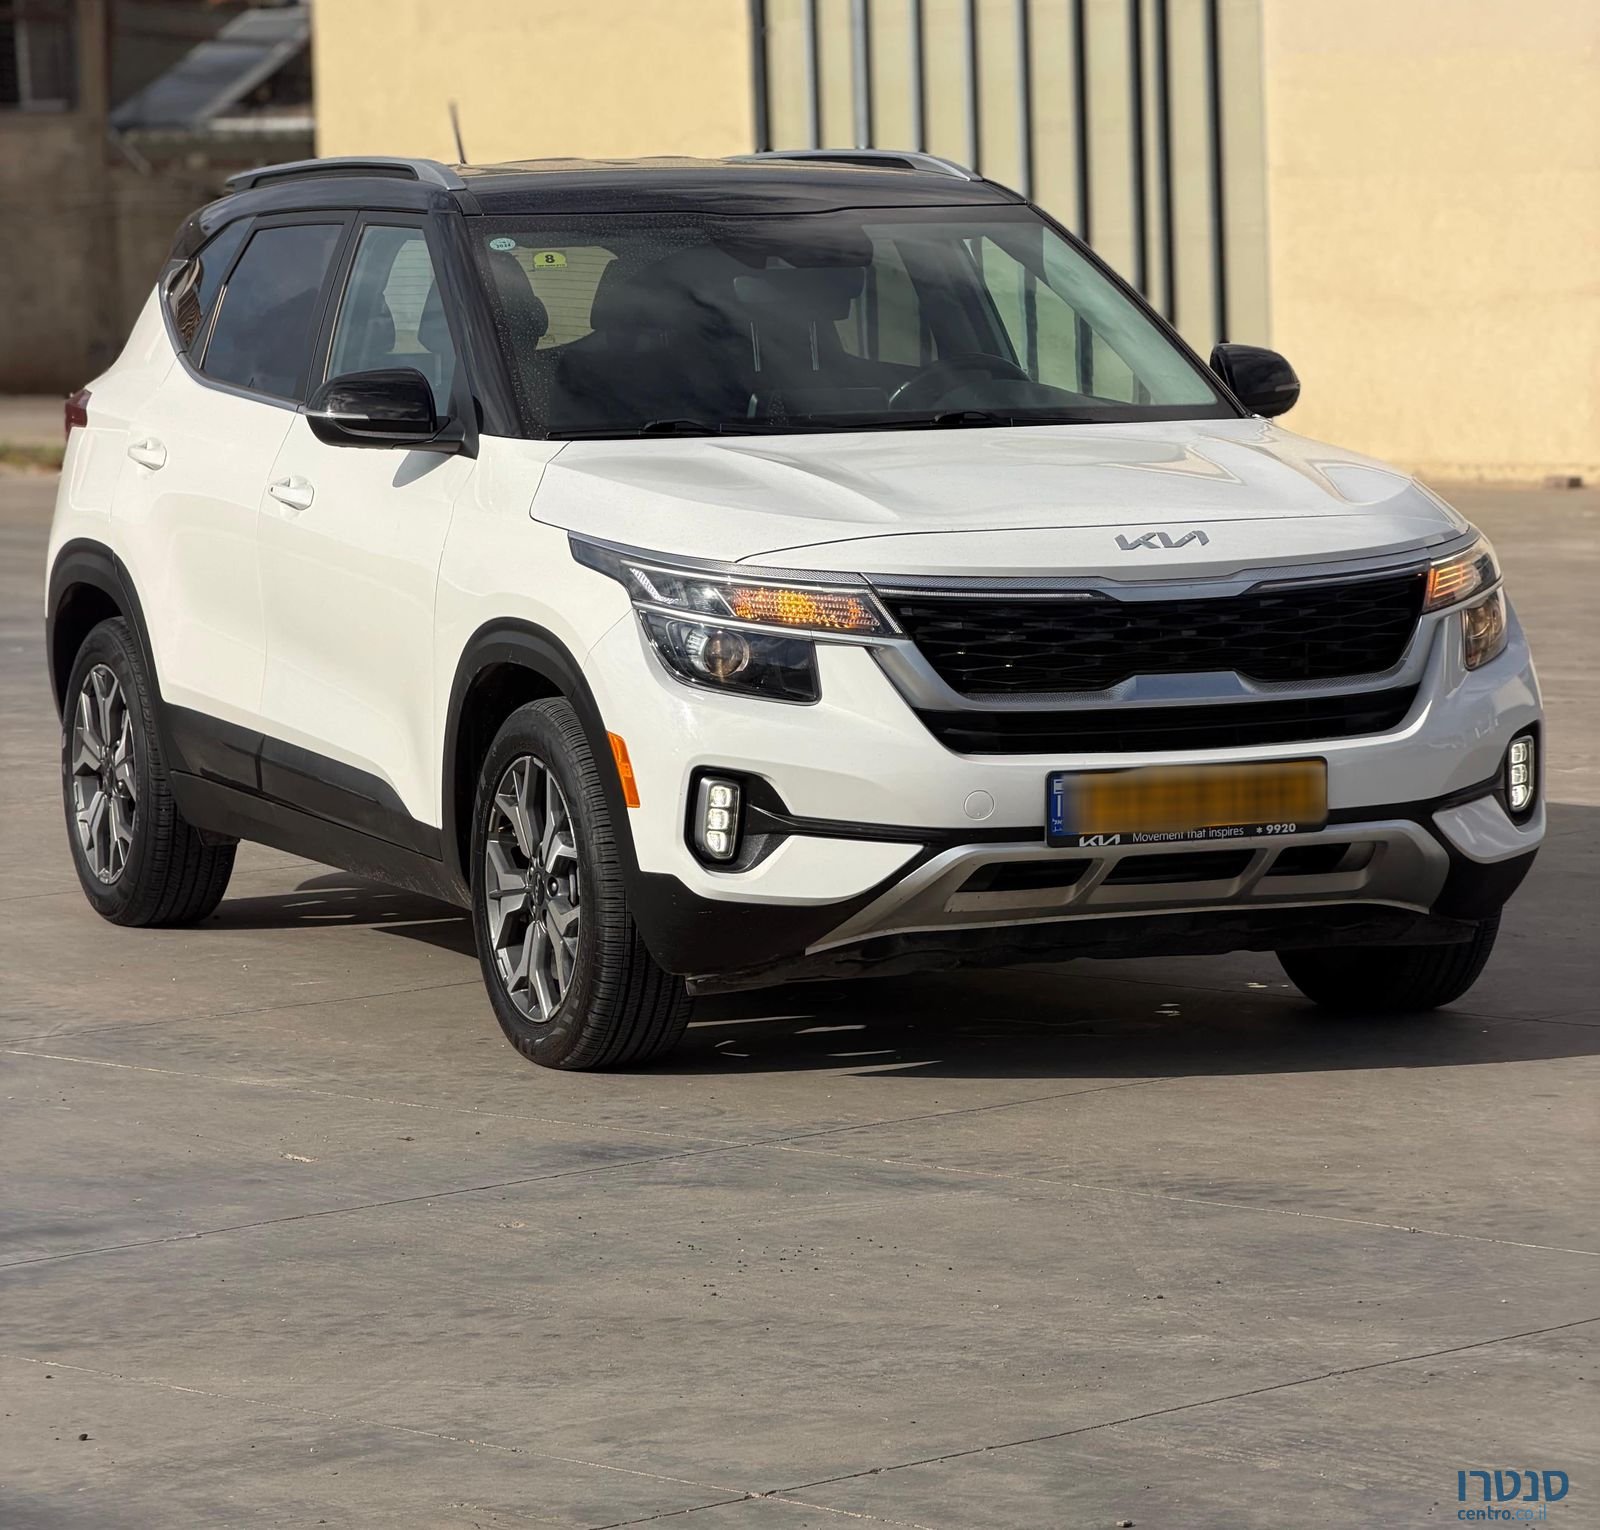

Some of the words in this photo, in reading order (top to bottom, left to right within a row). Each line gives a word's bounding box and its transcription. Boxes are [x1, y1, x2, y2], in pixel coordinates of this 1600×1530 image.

[545, 255, 555, 263] 8
[1114, 530, 1210, 551] KIA
[1079, 834, 1121, 847] KIA
[1132, 832, 1184, 843] Movement
[1187, 829, 1206, 840] that
[1209, 826, 1244, 838] inspires
